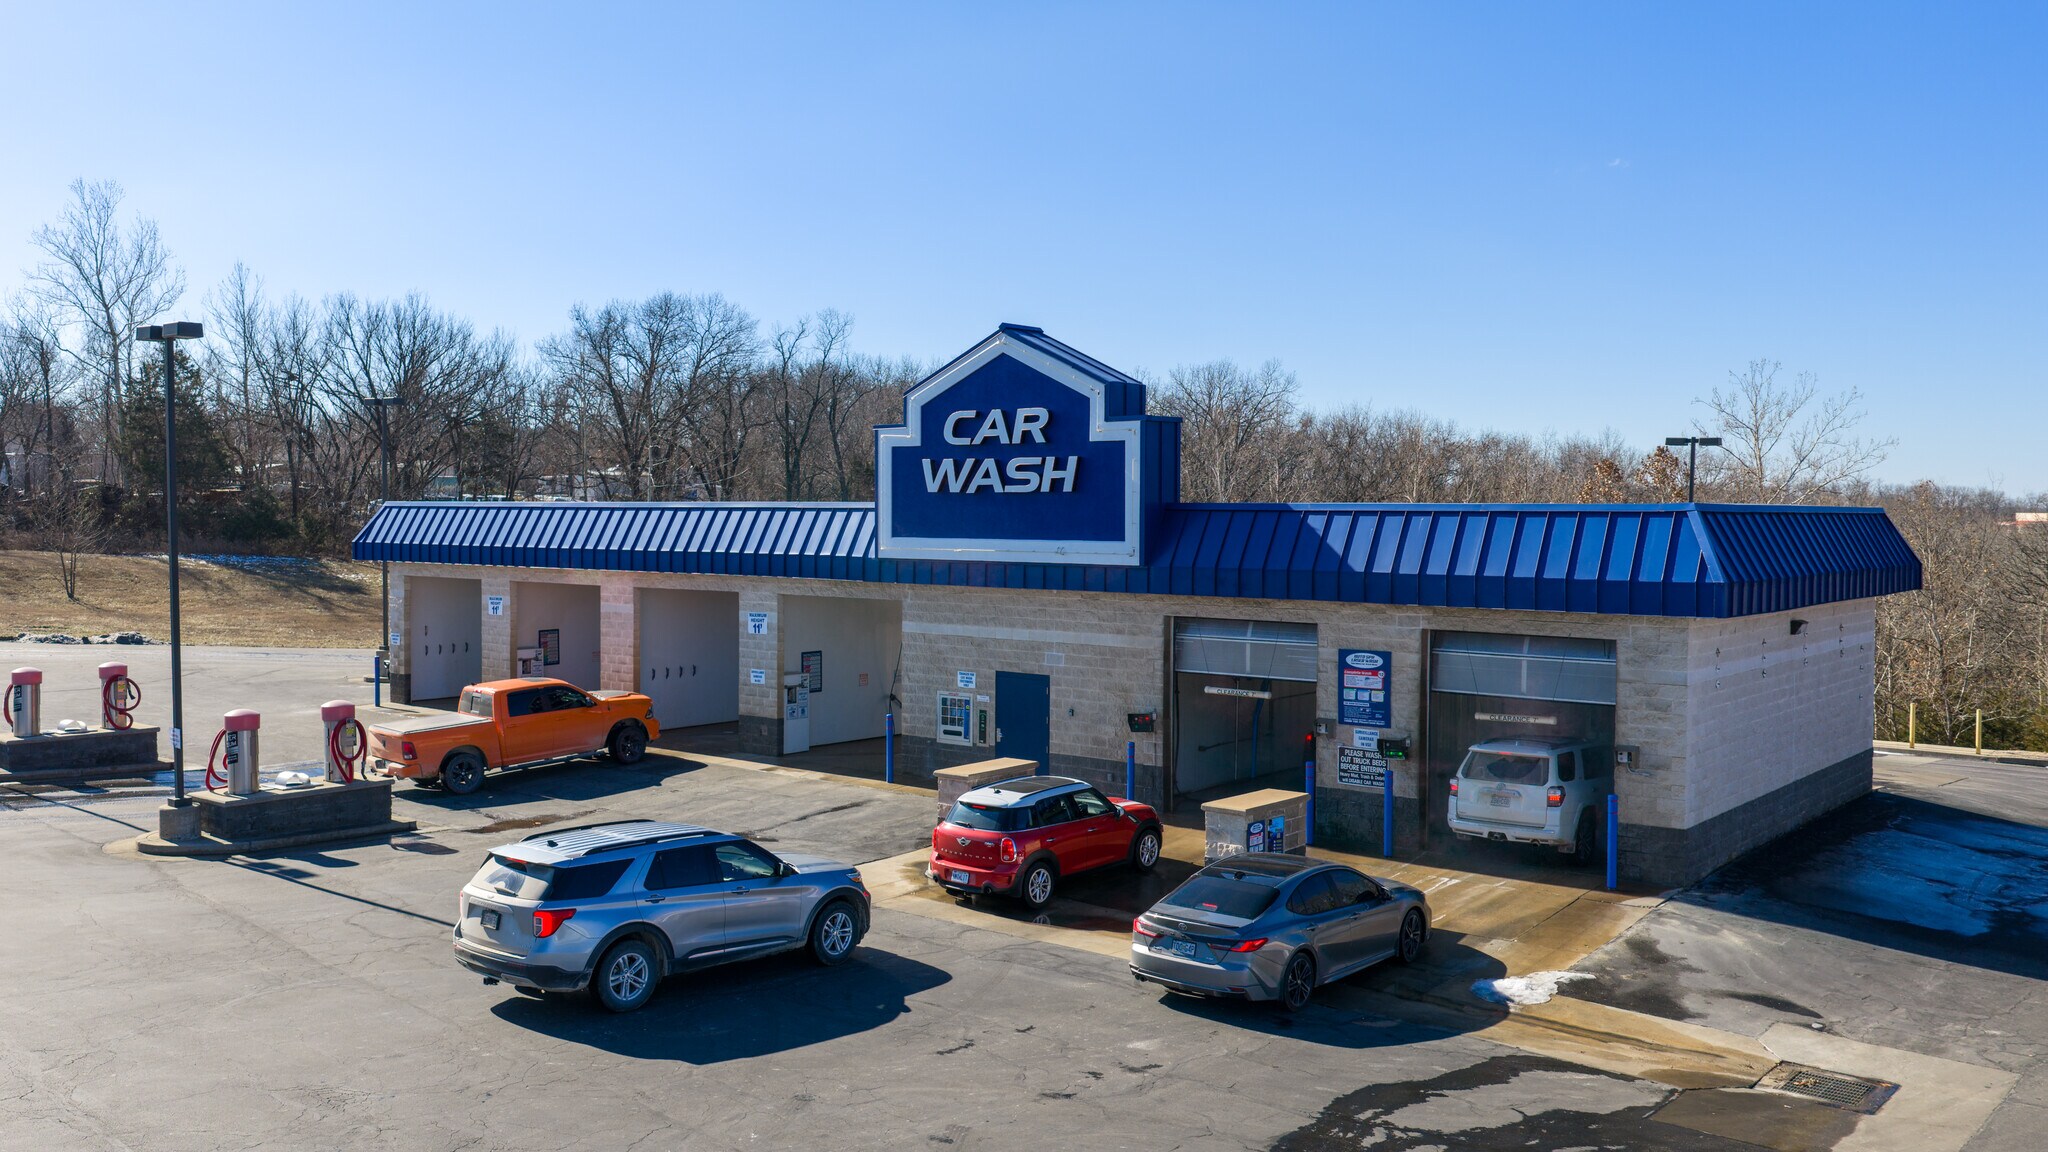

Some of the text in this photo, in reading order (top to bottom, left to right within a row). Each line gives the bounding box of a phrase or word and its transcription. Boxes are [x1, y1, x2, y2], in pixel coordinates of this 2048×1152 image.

[943, 407, 1049, 446] CAR
[921, 455, 1078, 494] WASH
[753, 623, 762, 634] 11'
[1216, 688, 1250, 697] CLEARANCE
[1489, 714, 1532, 723] CLEARANCE
[1344, 749, 1363, 758] PLEASE
[1340, 755, 1351, 763] OUT
[1352, 757, 1371, 766] TRUCK
[1340, 762, 1386, 774] BEFORE ENTERING
